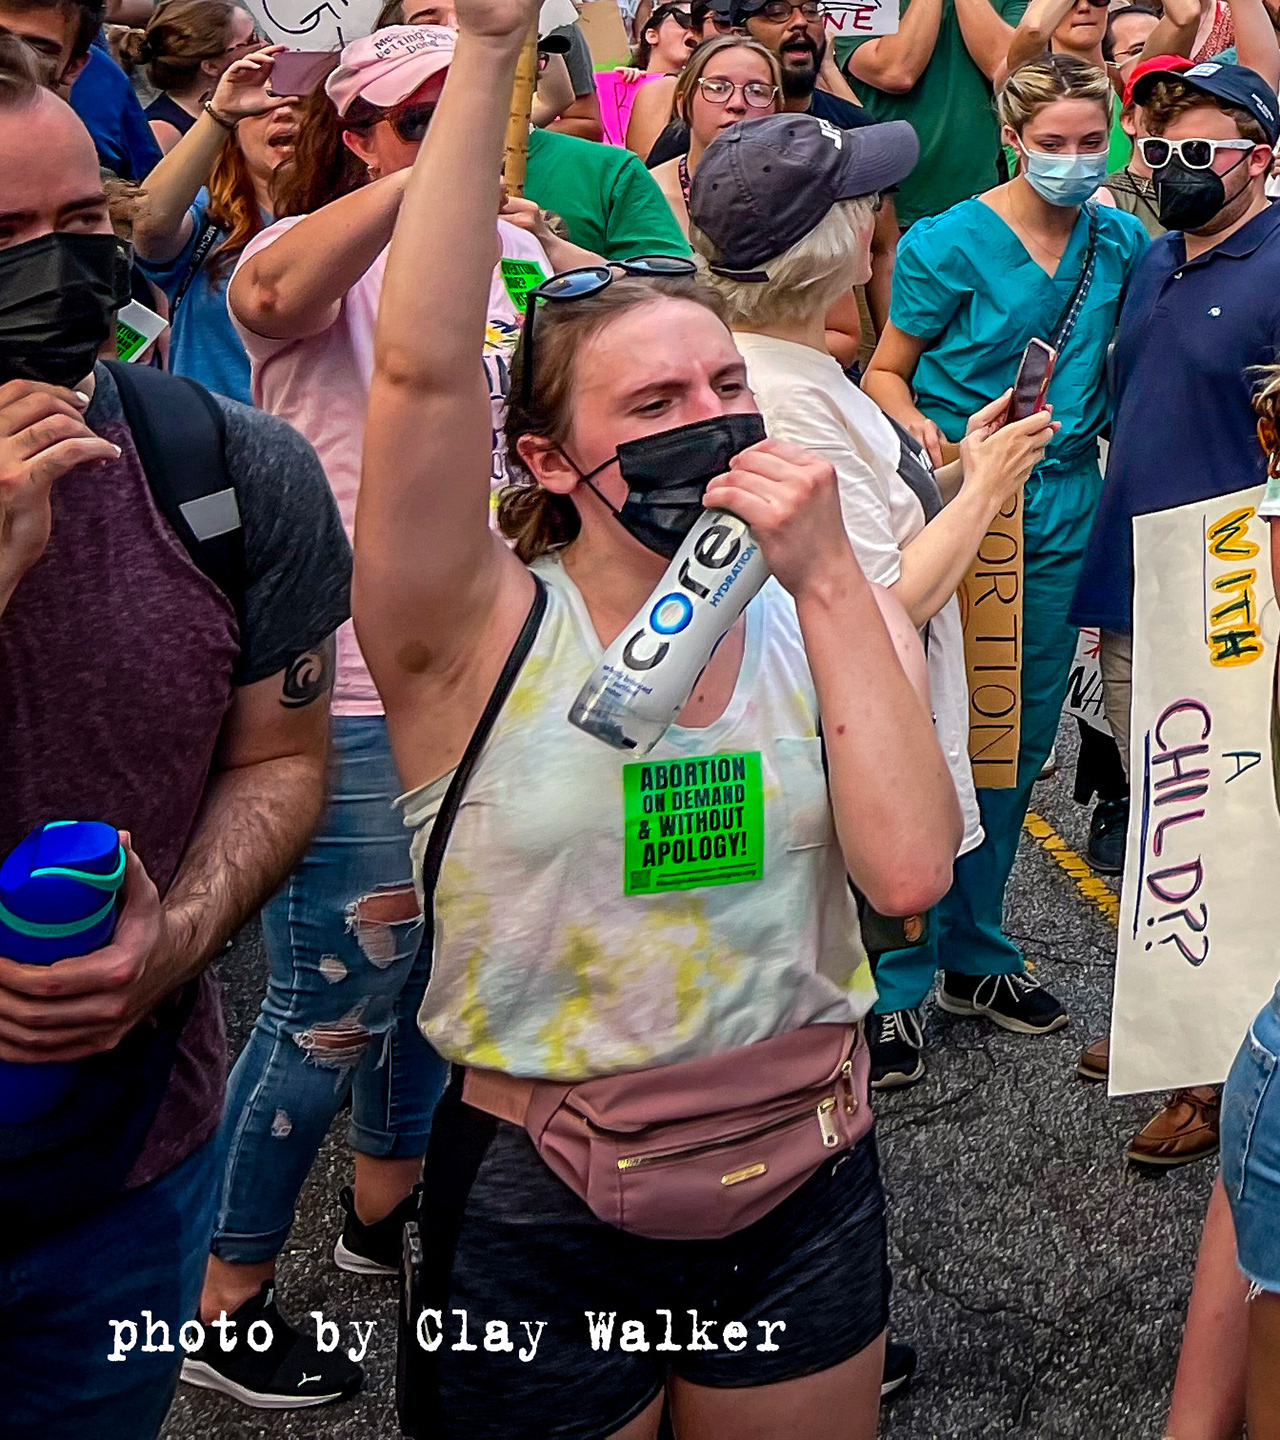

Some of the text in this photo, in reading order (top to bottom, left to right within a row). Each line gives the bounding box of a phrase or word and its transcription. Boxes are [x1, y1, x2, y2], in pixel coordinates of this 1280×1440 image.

[709, 542, 758, 608] HYDRATION
[622, 523, 742, 672] core
[1208, 509, 1263, 785] WITH A
[640, 756, 746, 792] ABORTION
[642, 784, 745, 814] ON DEMAND
[638, 806, 745, 840] & WITHOUT
[641, 831, 747, 868] APOLOGY!
